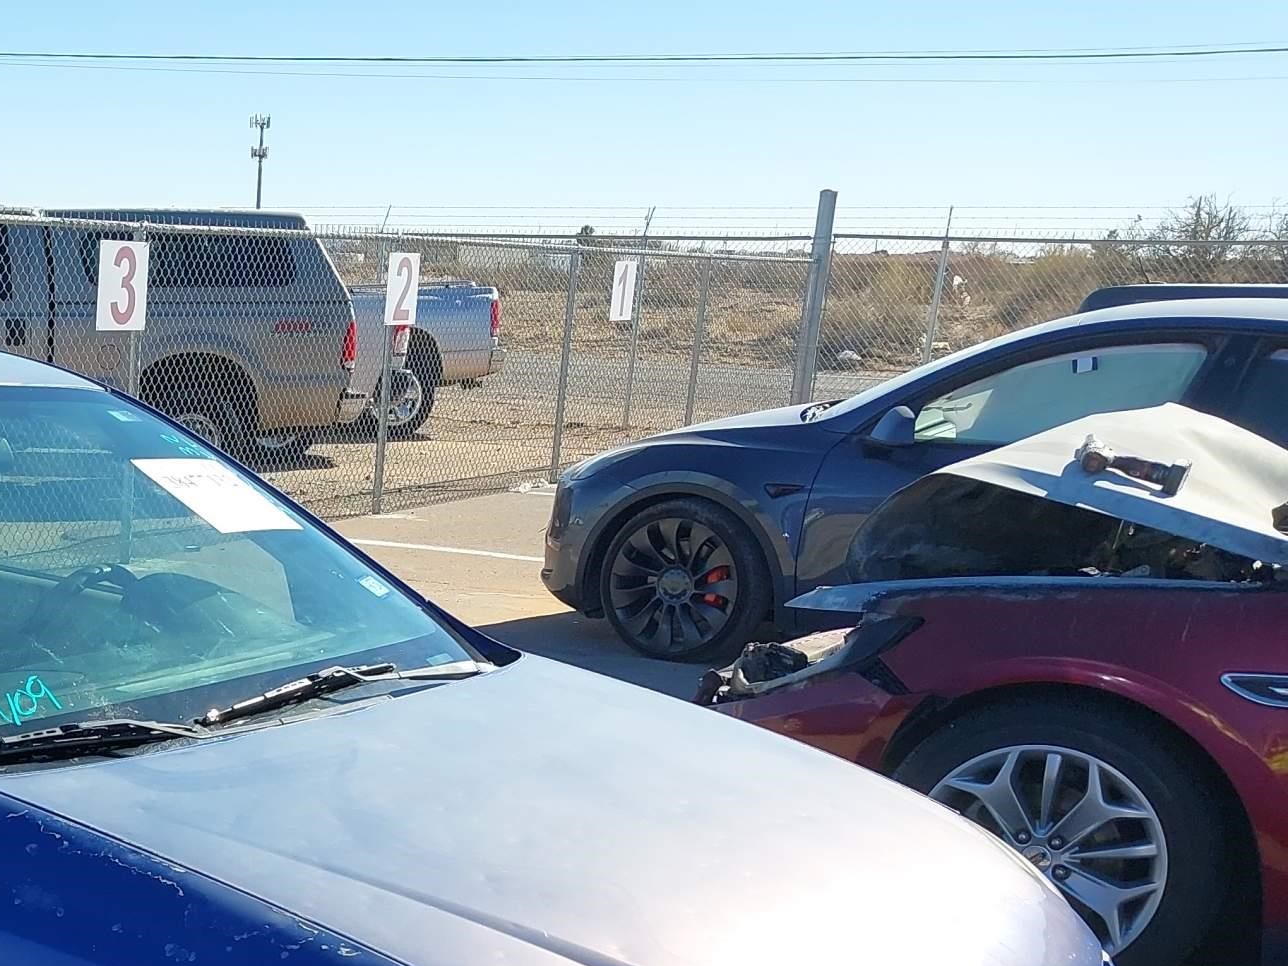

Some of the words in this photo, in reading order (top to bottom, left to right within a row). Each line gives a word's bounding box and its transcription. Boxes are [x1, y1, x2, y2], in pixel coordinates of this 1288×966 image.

[110, 246, 138, 326] 3
[392, 256, 414, 321] 2
[617, 264, 629, 316] 1
